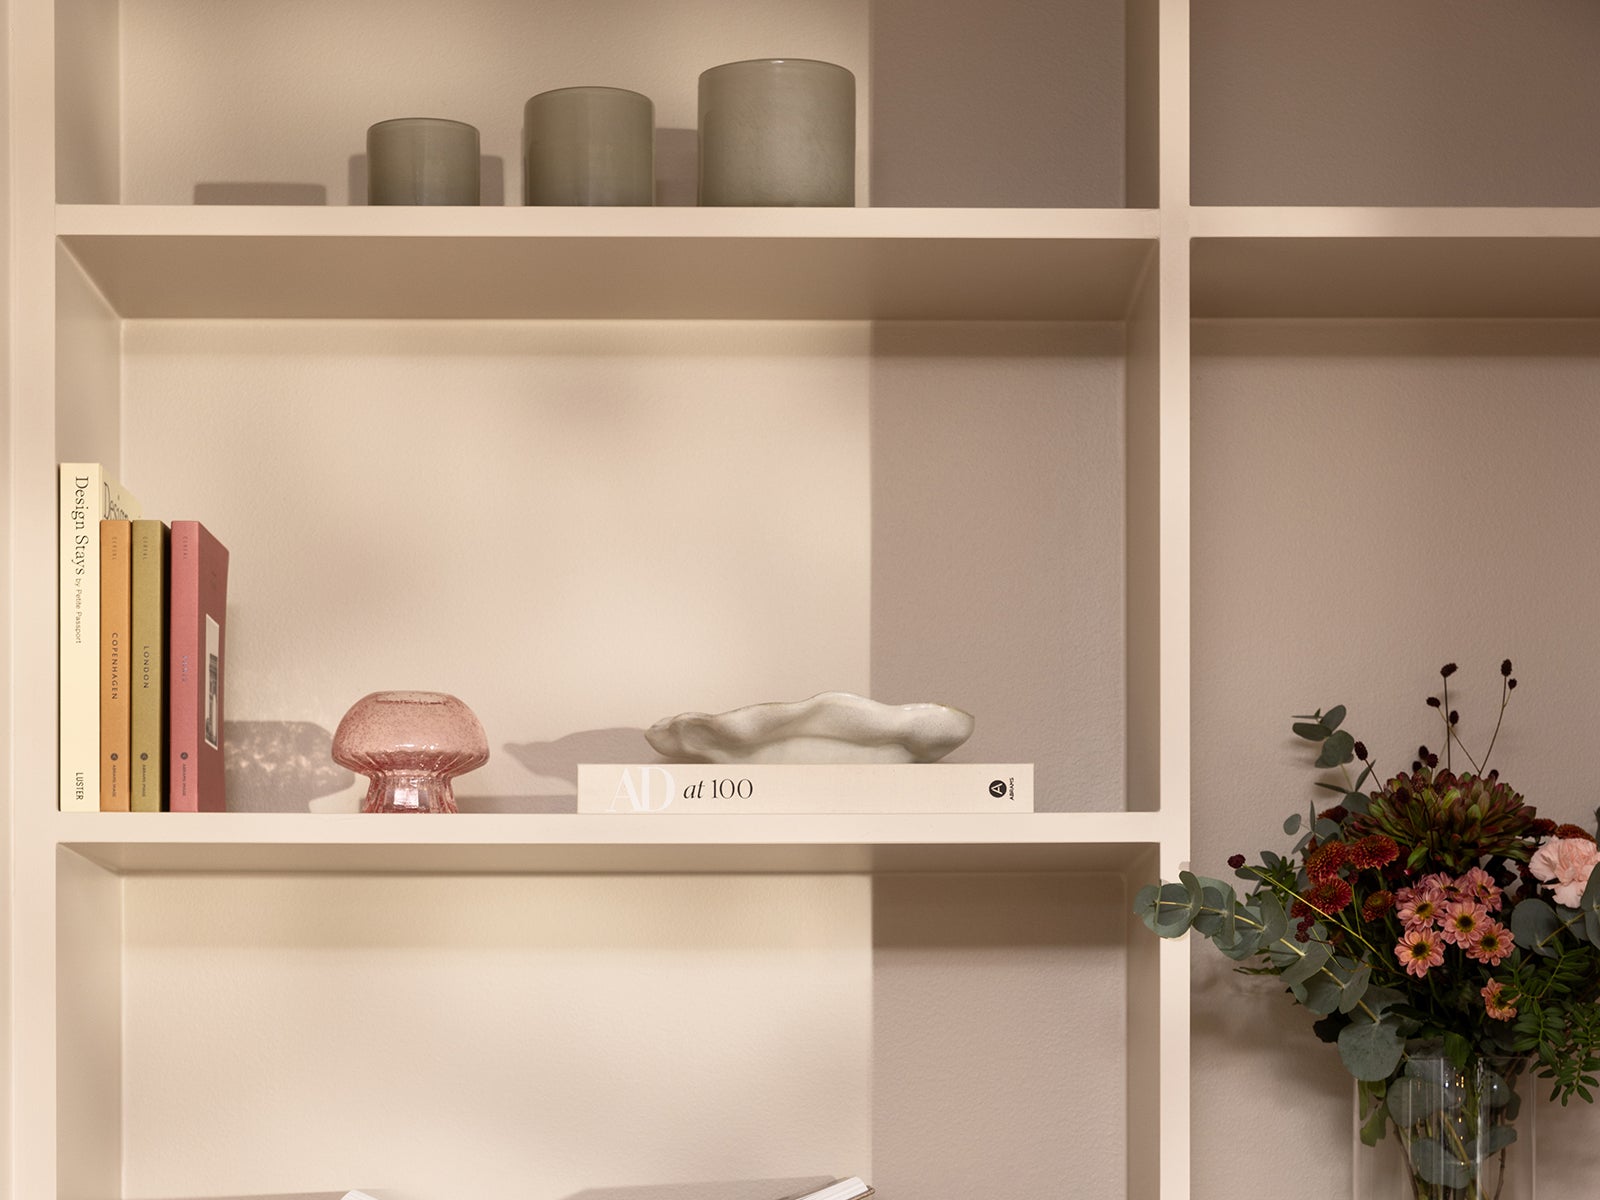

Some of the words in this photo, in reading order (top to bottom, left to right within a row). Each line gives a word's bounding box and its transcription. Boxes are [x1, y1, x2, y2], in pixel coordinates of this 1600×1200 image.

[71, 476, 89, 530] Design
[71, 535, 89, 575] Stays
[74, 578, 83, 588] by
[75, 589, 83, 610] Petite
[73, 611, 83, 644] Passport
[110, 632, 118, 700] COPENHAGEN
[75, 772, 84, 800] LUSTER
[606, 766, 676, 812] AD
[683, 780, 705, 799] at
[711, 778, 753, 799] 100
